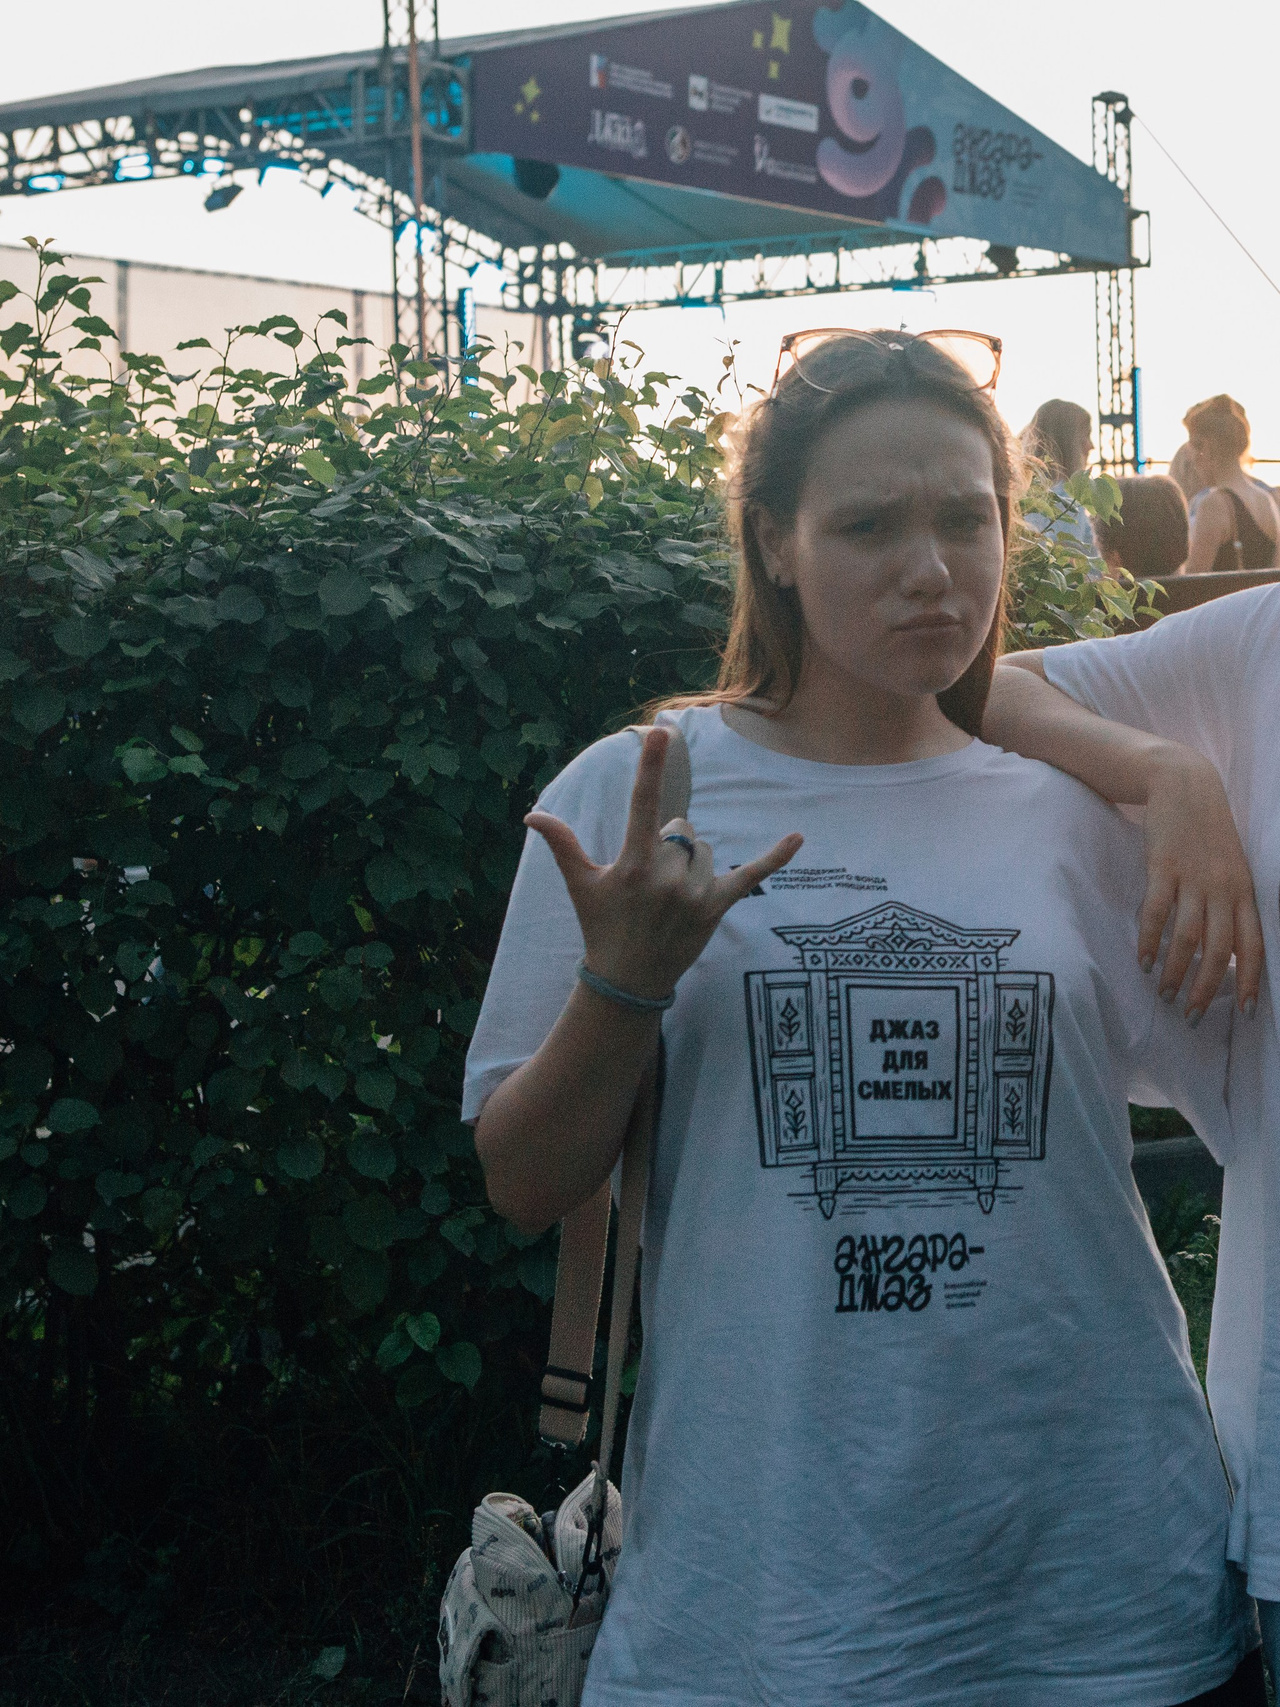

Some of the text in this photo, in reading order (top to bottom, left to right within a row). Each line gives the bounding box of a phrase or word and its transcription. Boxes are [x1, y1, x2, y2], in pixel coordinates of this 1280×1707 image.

[869, 1019, 940, 1043] ДЖАЗ
[882, 1049, 929, 1074] ДЛЯ
[858, 1080, 953, 1101] СМЕЛЫХ
